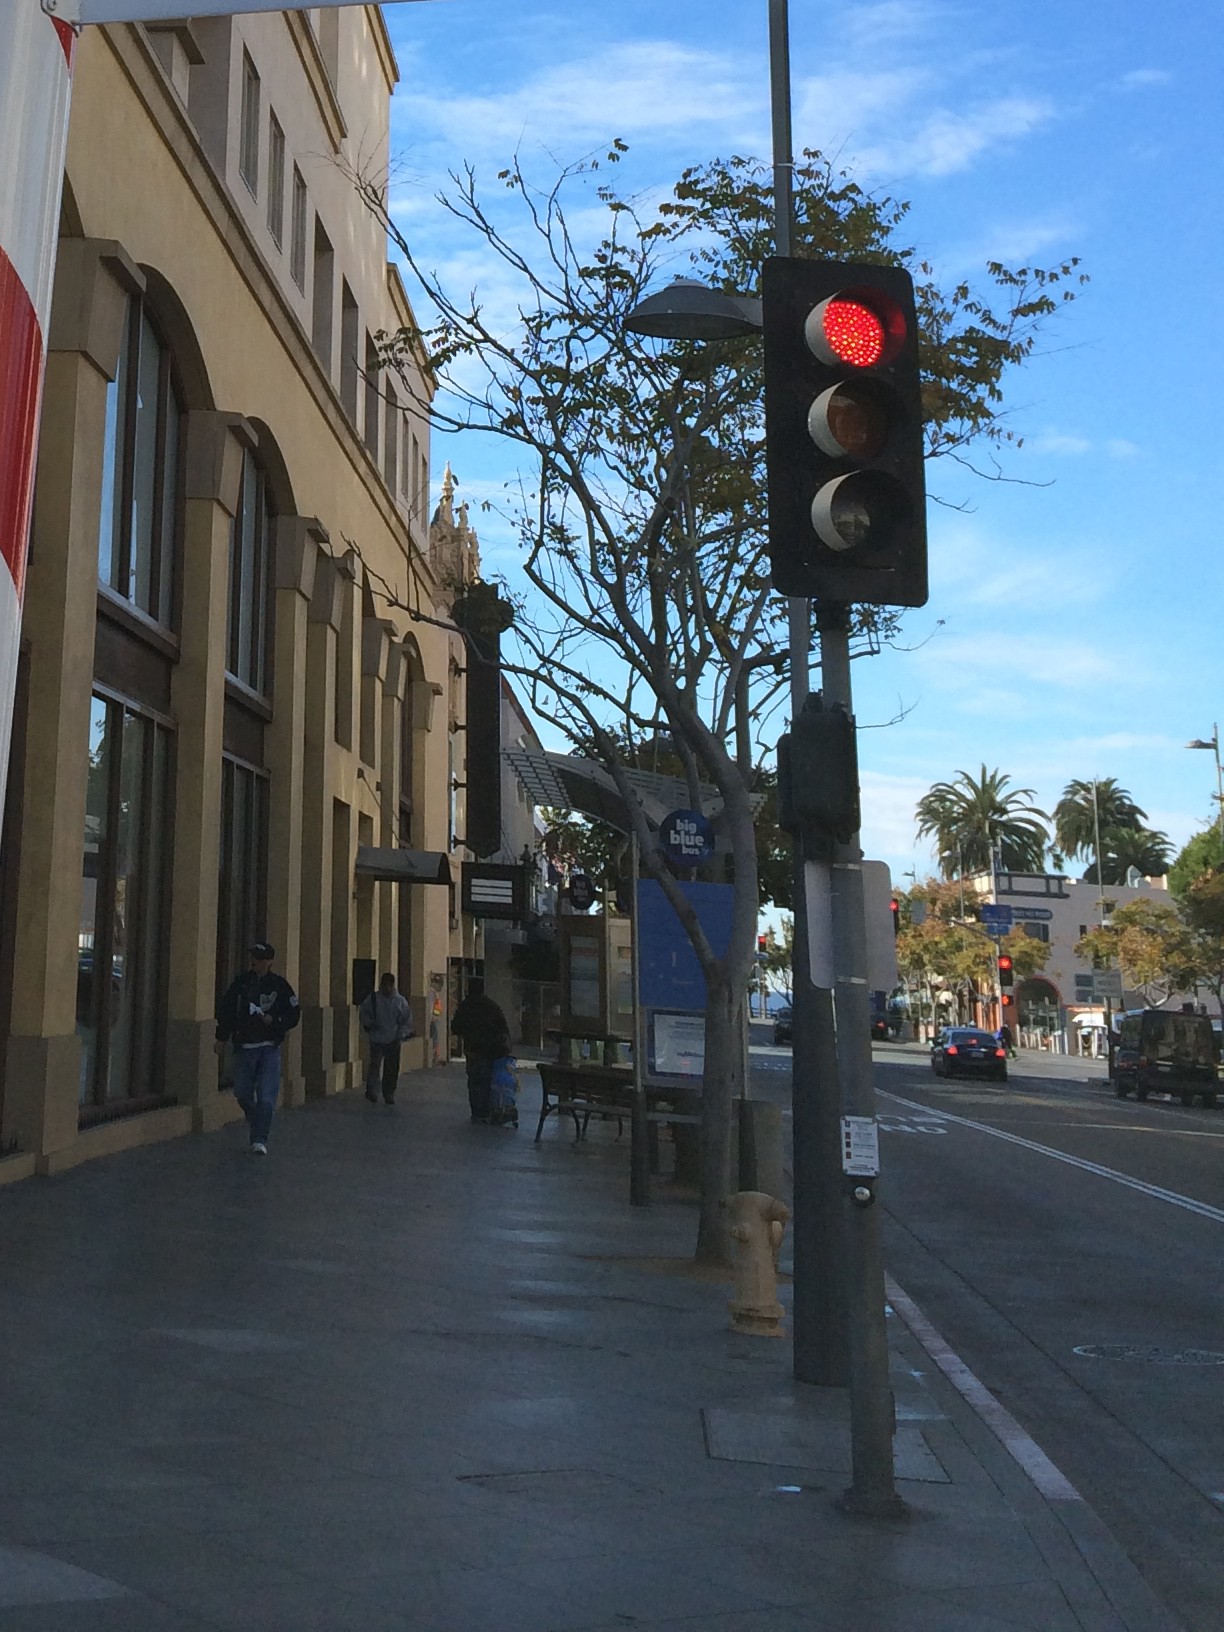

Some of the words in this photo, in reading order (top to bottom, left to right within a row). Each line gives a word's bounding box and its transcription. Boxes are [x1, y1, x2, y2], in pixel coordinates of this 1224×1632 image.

[676, 818, 697, 835] big
[670, 829, 705, 847] blue
[681, 844, 700, 856] bus
